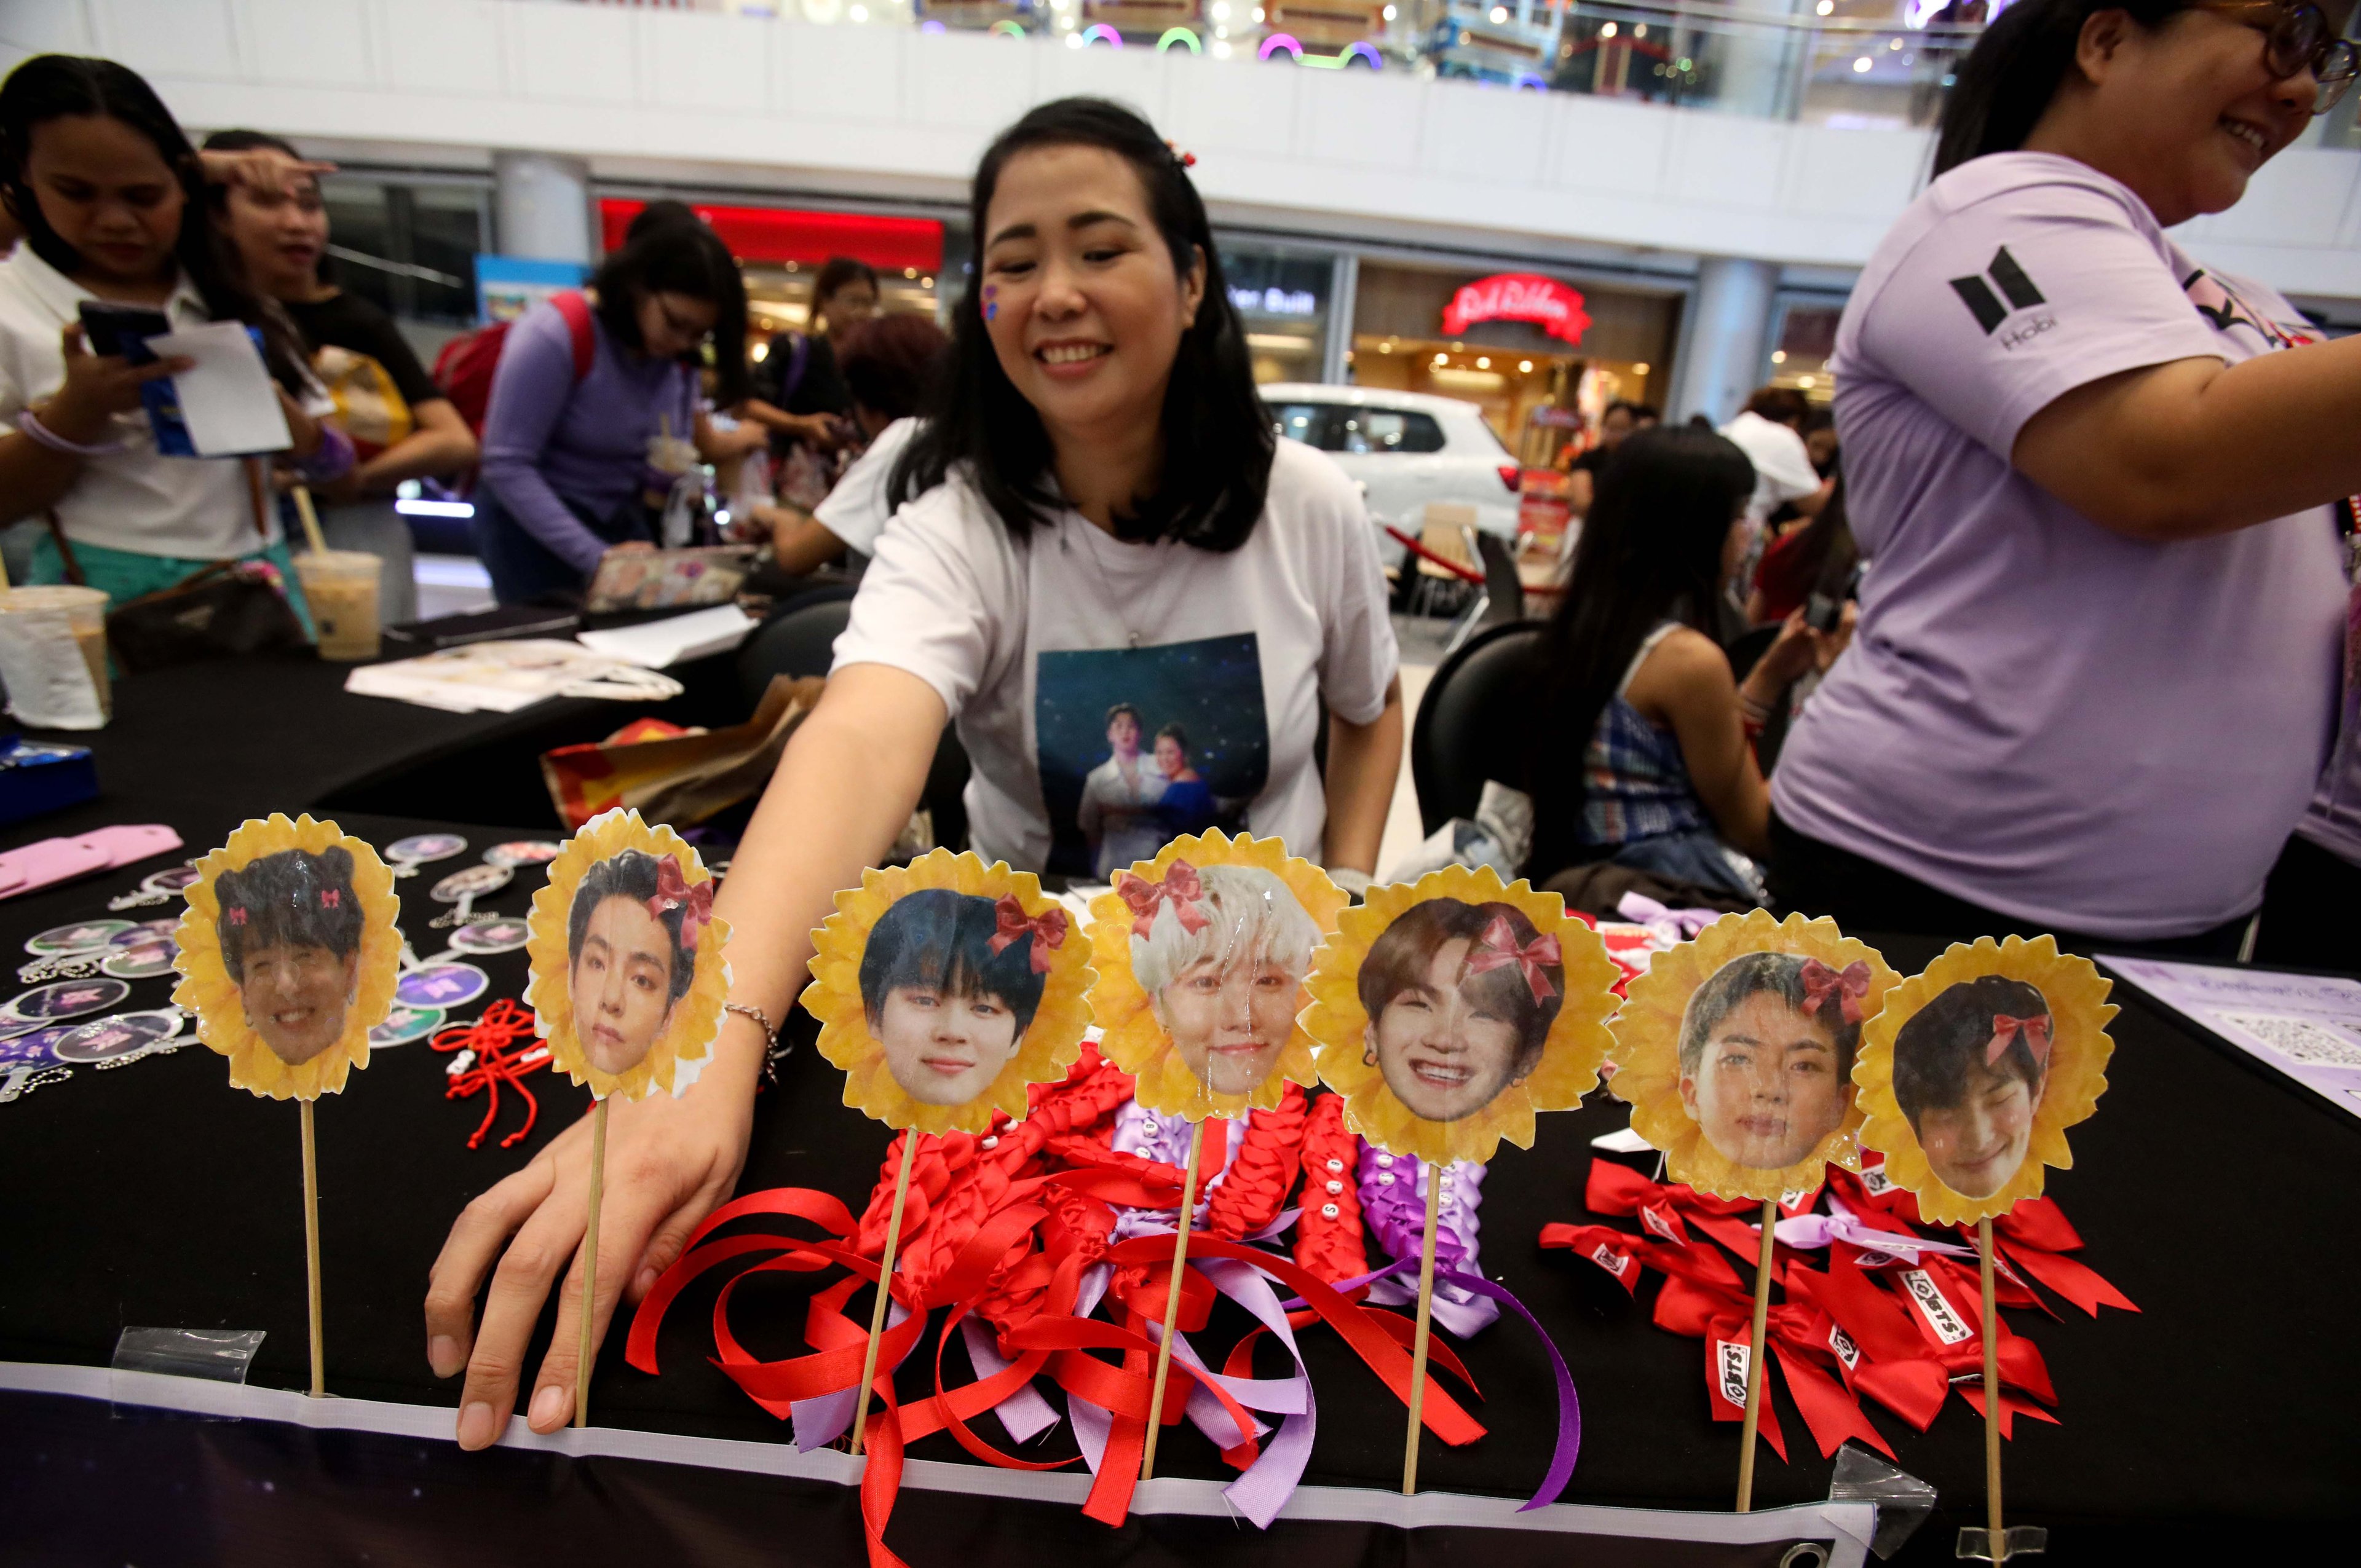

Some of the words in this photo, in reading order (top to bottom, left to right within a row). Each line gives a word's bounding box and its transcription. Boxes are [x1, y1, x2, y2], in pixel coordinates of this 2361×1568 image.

[2000, 314, 2057, 351] Hobi
[1926, 1300, 1959, 1333] BTS
[1727, 1350, 1743, 1385] BTS
